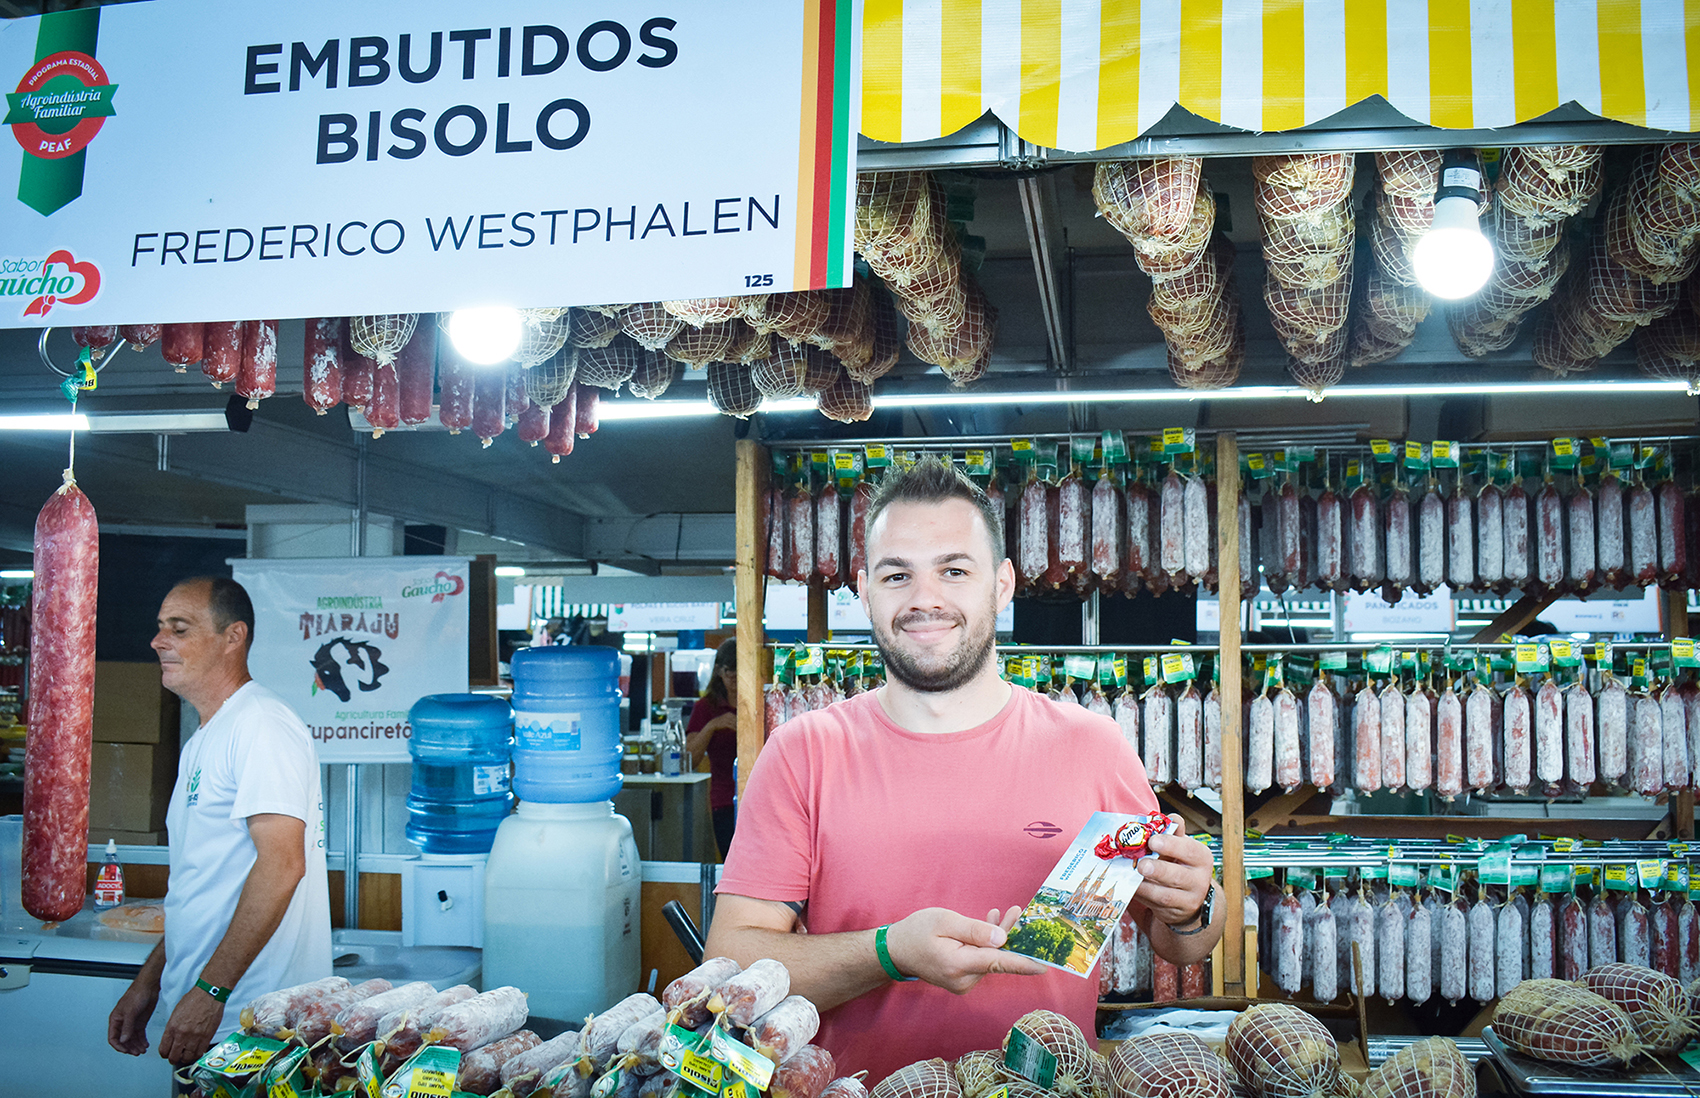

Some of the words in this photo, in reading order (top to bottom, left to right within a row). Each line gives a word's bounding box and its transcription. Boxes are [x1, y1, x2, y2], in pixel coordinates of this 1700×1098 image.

[244, 17, 678, 95] EMBUTIDOS
[29, 59, 68, 86] PROGRAMA
[69, 58, 99, 81] ESTADUAL
[21, 89, 102, 109] Agroindústria
[34, 104, 87, 119] Familiar
[316, 98, 591, 164] BISOLO
[39, 138, 72, 153] PEAF
[131, 219, 405, 267] FREDERICO
[425, 194, 781, 251] WESTPHALEN
[0, 258, 45, 274] Sabor
[744, 273, 774, 288] 125
[317, 594, 383, 609] AGROINDÚSTRIA
[1365, 601, 1439, 610] PANICADOS
[299, 611, 399, 640] TIARAJU
[335, 710, 384, 721] Agricultura
